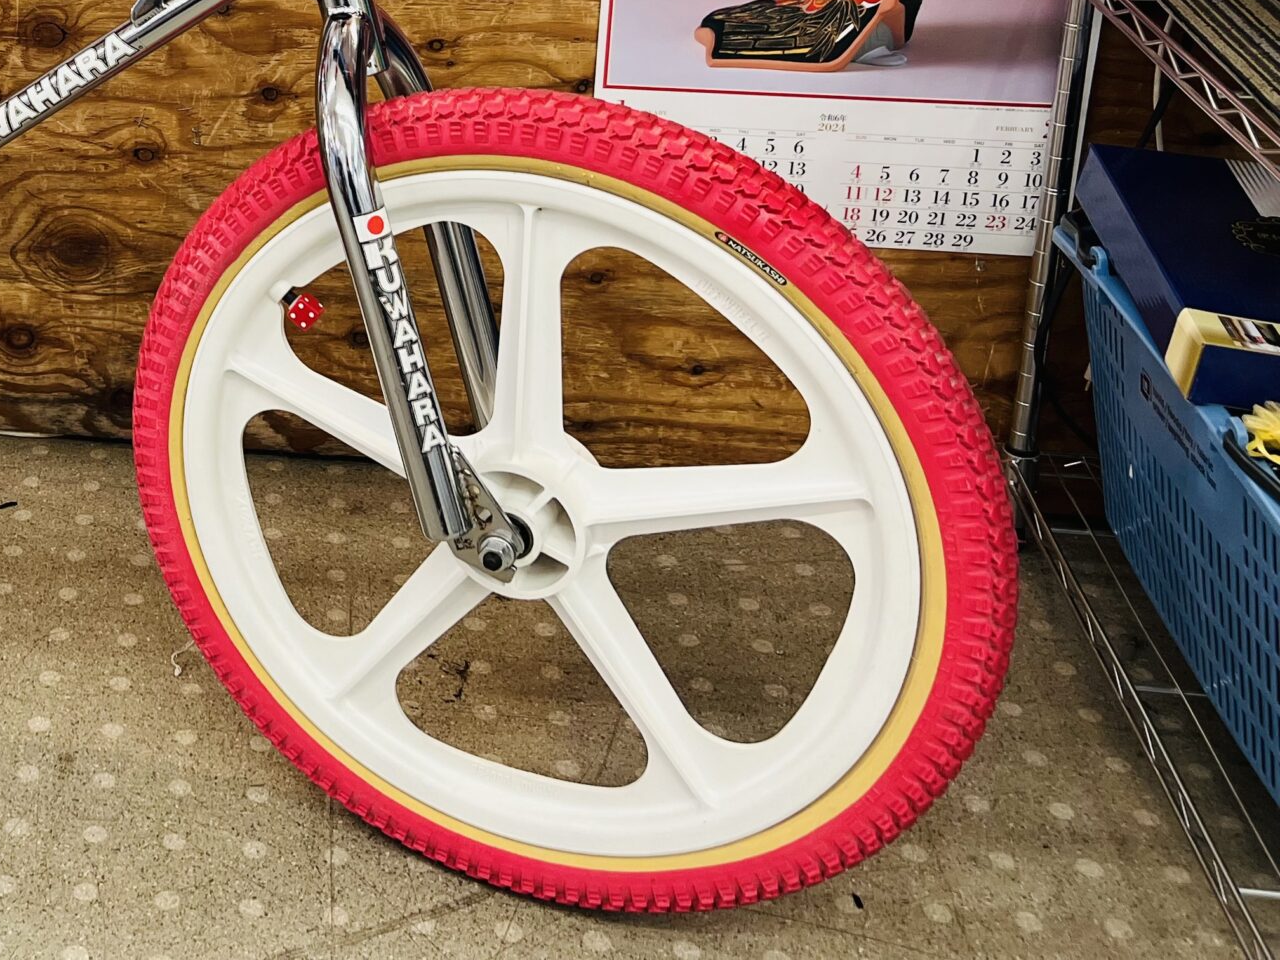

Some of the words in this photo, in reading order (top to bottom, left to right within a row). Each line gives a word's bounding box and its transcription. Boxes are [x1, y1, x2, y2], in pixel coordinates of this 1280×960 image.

[820, 113, 847, 122] 令和6年
[817, 122, 846, 133] 2024
[736, 136, 747, 152] 4
[764, 138, 776, 153] 5
[793, 140, 805, 155] 6
[973, 148, 980, 163] 1
[1000, 149, 1012, 164] 2
[1030, 150, 1042, 166] 3
[788, 161, 807, 177] 13
[850, 164, 861, 179] 4
[880, 165, 890, 180] 5
[909, 167, 920, 182] 6
[939, 168, 950, 183] 7
[967, 170, 979, 185] 8
[998, 171, 1009, 187] 9
[1023, 173, 1043, 188] 10
[846, 185, 861, 200] 11
[874, 187, 893, 202] 12
[903, 189, 921, 204] 13
[931, 190, 951, 205] 14
[961, 192, 980, 207] 15
[990, 193, 1010, 208] 16
[1021, 195, 1040, 210] 17
[843, 207, 861, 221] 18
[871, 208, 890, 223] 19
[897, 210, 919, 225] 20
[927, 212, 946, 226] 21
[955, 213, 977, 228] 22
[984, 215, 1007, 230] 23
[1013, 216, 1037, 231] 24
[865, 229, 887, 243] 26
[894, 230, 916, 245] 27
[923, 232, 945, 246] 28
[951, 234, 974, 248] 29
[727, 239, 786, 285] NATSUKASHI
[362, 233, 447, 455] KUWAHARA
